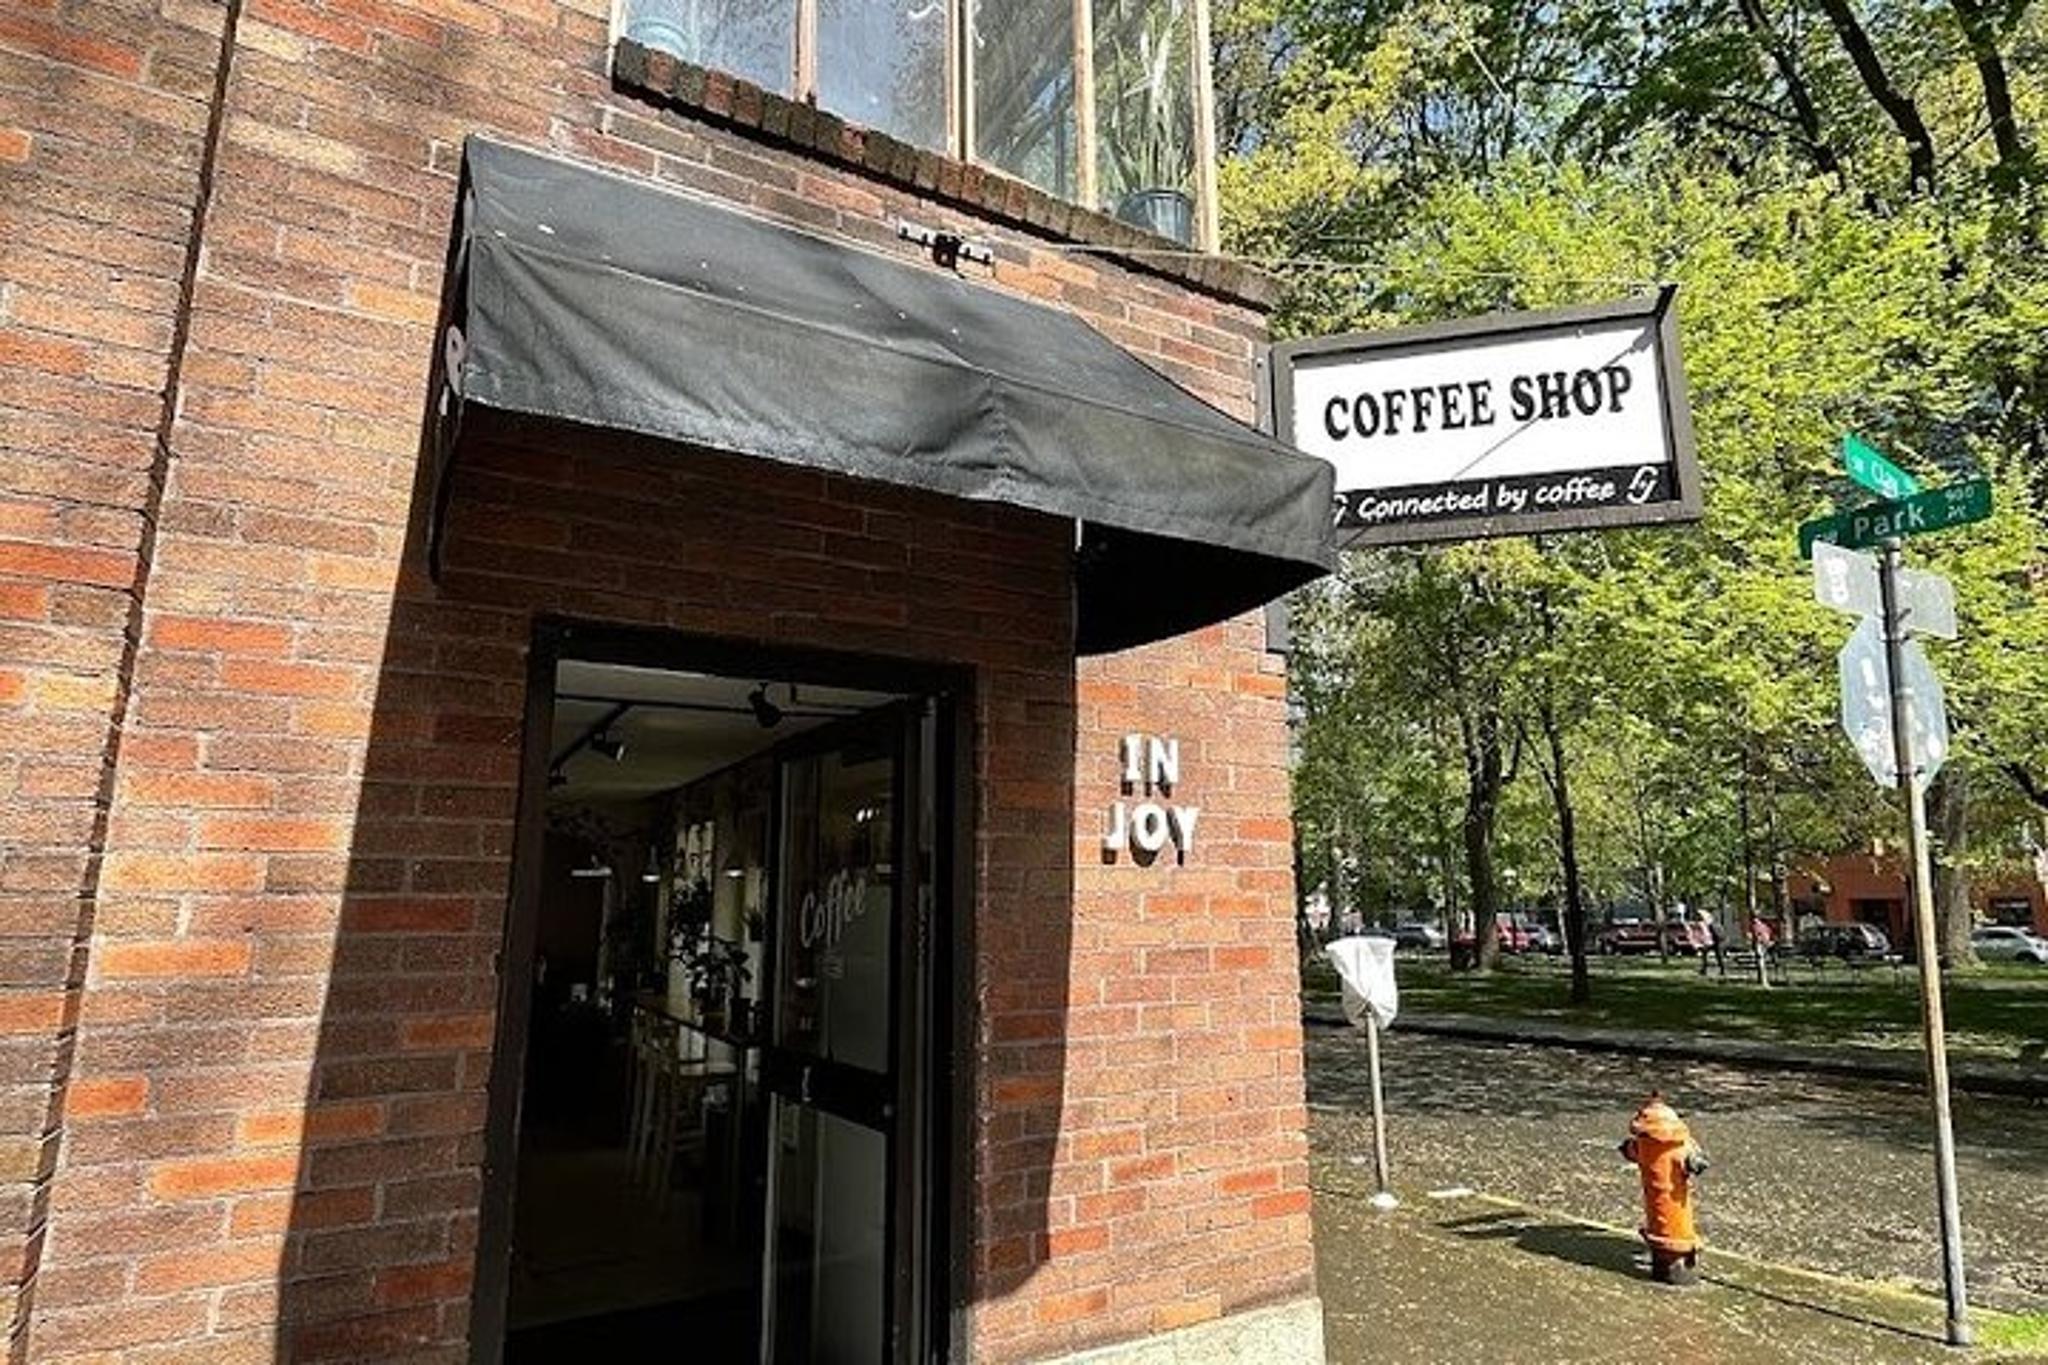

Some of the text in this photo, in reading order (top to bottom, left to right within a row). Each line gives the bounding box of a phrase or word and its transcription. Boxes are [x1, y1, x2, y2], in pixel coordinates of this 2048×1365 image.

[1324, 365, 1633, 440] COFFEE SHOP
[1358, 477, 1616, 521] Connected by coffee
[1853, 502, 1926, 541] Park
[1125, 733, 1179, 783] IN
[1104, 801, 1200, 853] JOY
[801, 867, 867, 949] Coffee
